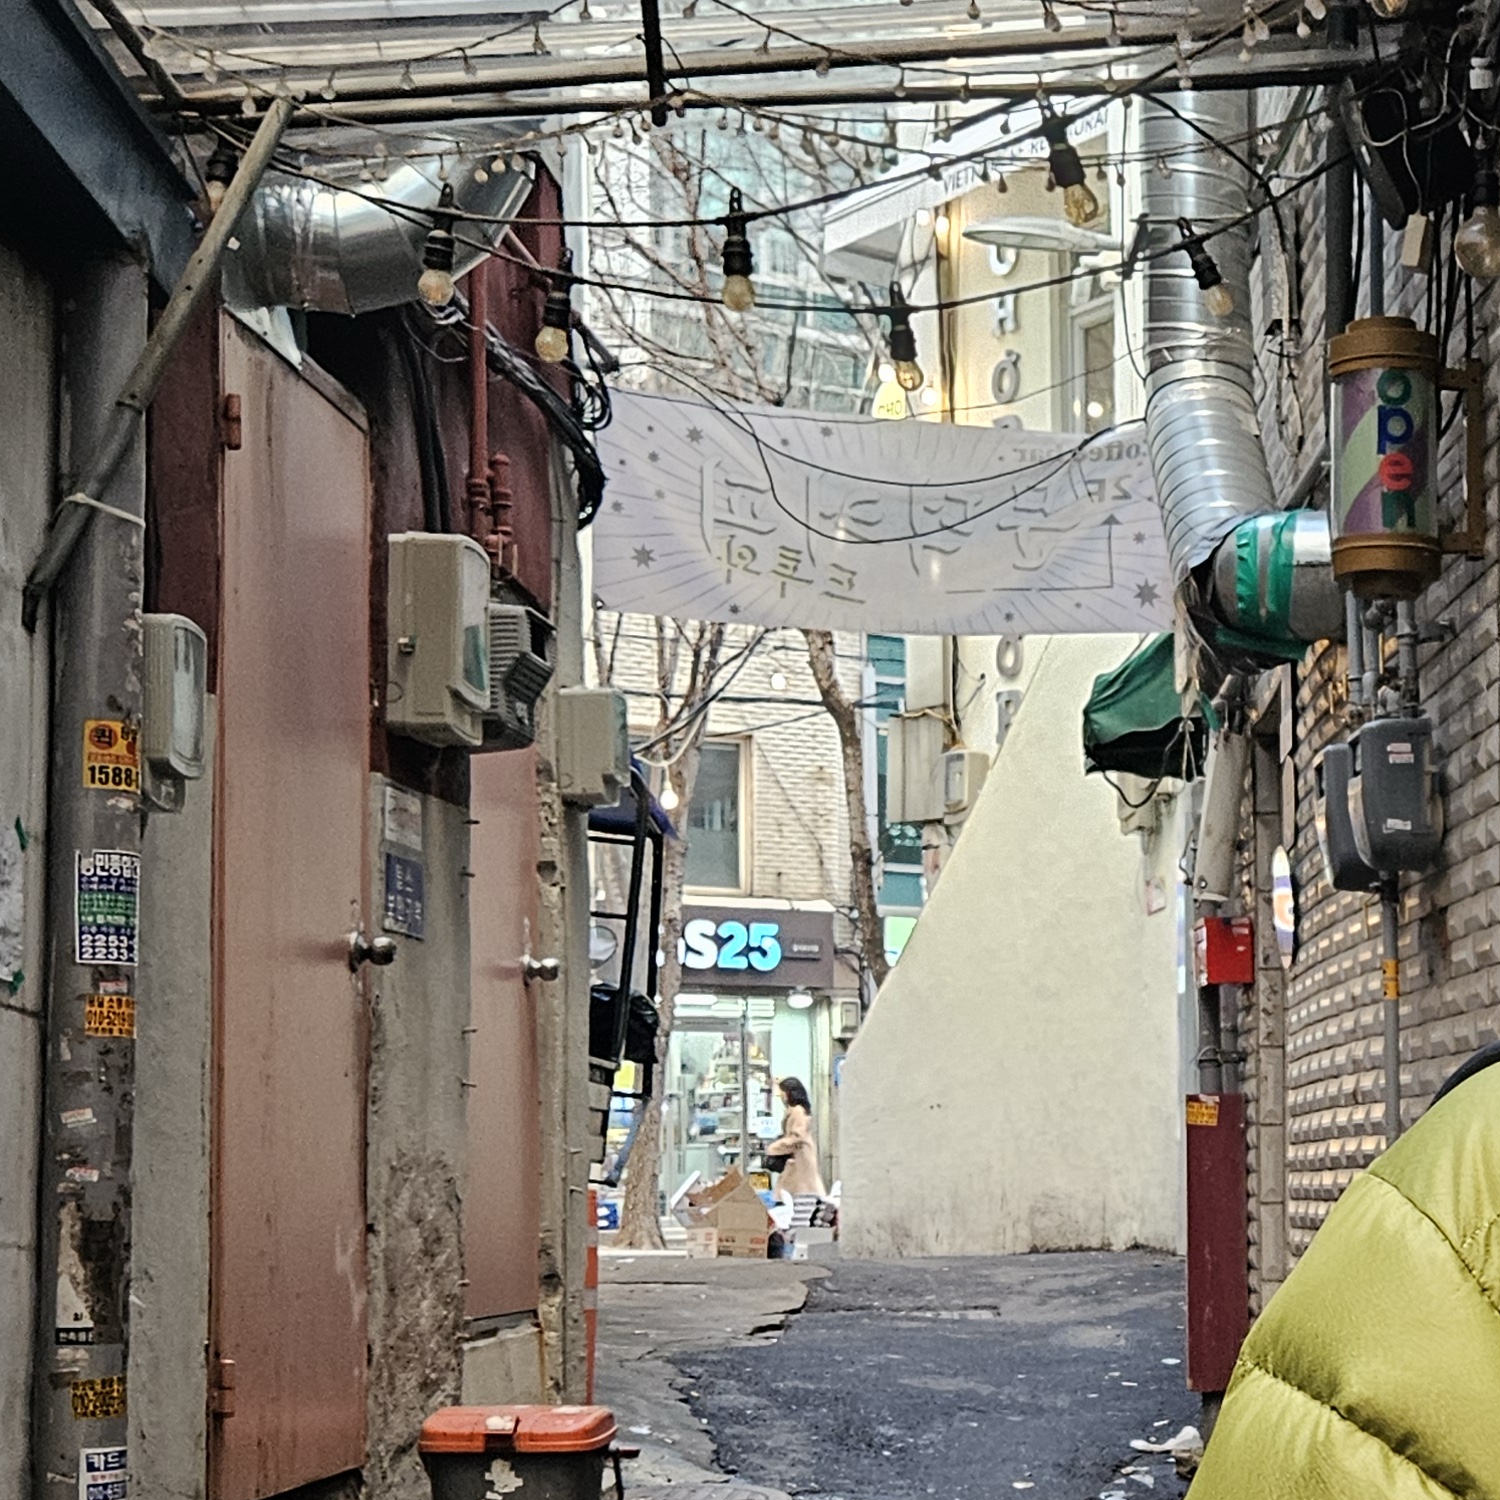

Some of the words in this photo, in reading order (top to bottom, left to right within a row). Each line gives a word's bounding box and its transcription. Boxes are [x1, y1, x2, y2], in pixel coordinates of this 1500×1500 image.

[1376, 367, 1416, 530] open
[81, 933, 136, 947] 2253-
[677, 919, 783, 972] S25
